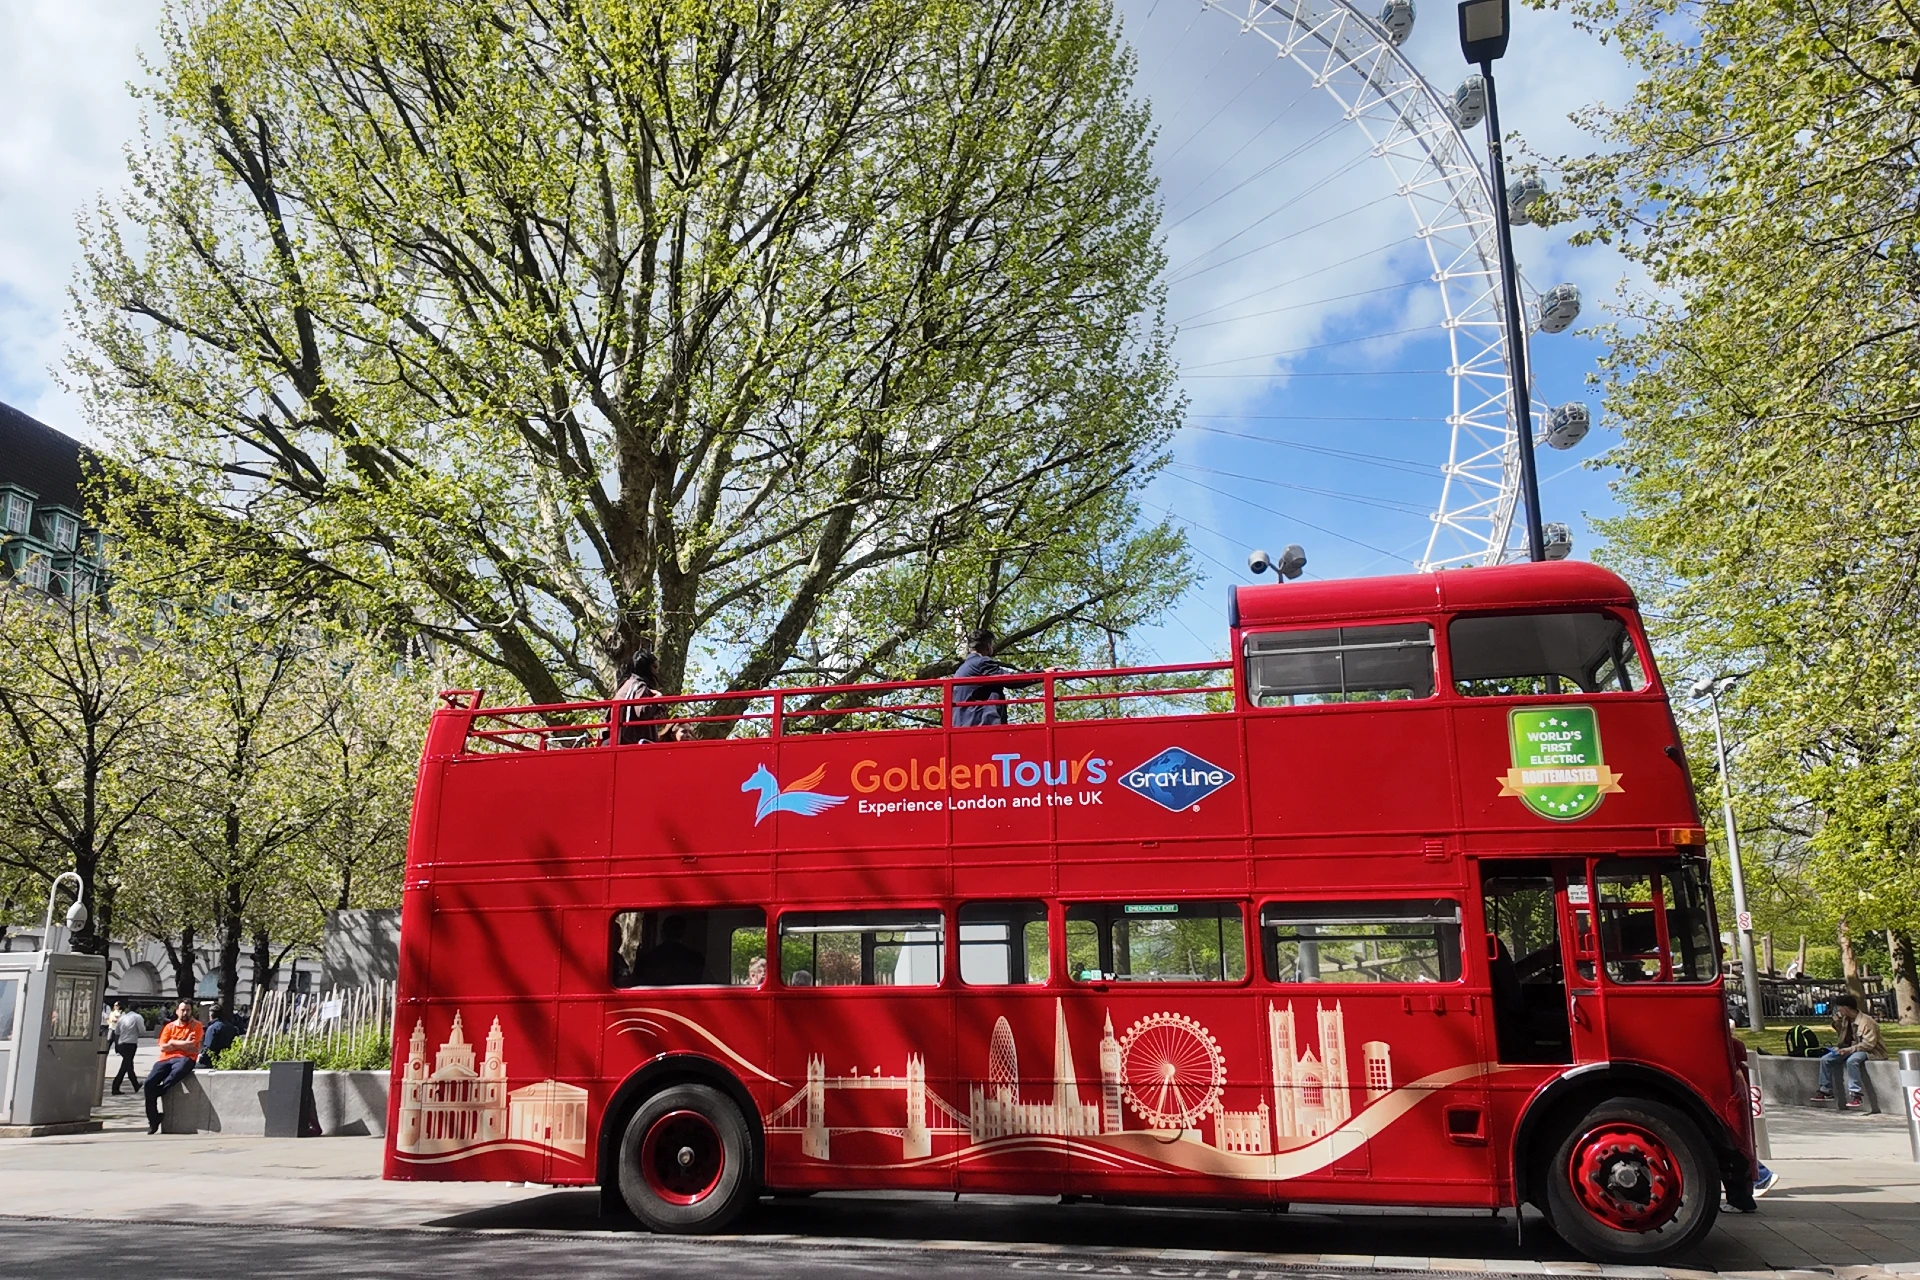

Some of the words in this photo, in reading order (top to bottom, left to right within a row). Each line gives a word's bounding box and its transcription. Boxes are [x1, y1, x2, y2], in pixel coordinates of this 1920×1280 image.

[1526, 730, 1583, 742] WORLD'S
[1540, 742, 1573, 753] FIRST
[1530, 753, 1586, 765] ELECTRIC
[1521, 768, 1599, 784] ROUTEMASTER
[858, 798, 944, 818] Experience
[948, 794, 1007, 810] London
[1012, 792, 1042, 808] and
[1046, 791, 1074, 806] the
[1078, 790, 1104, 806] UK
